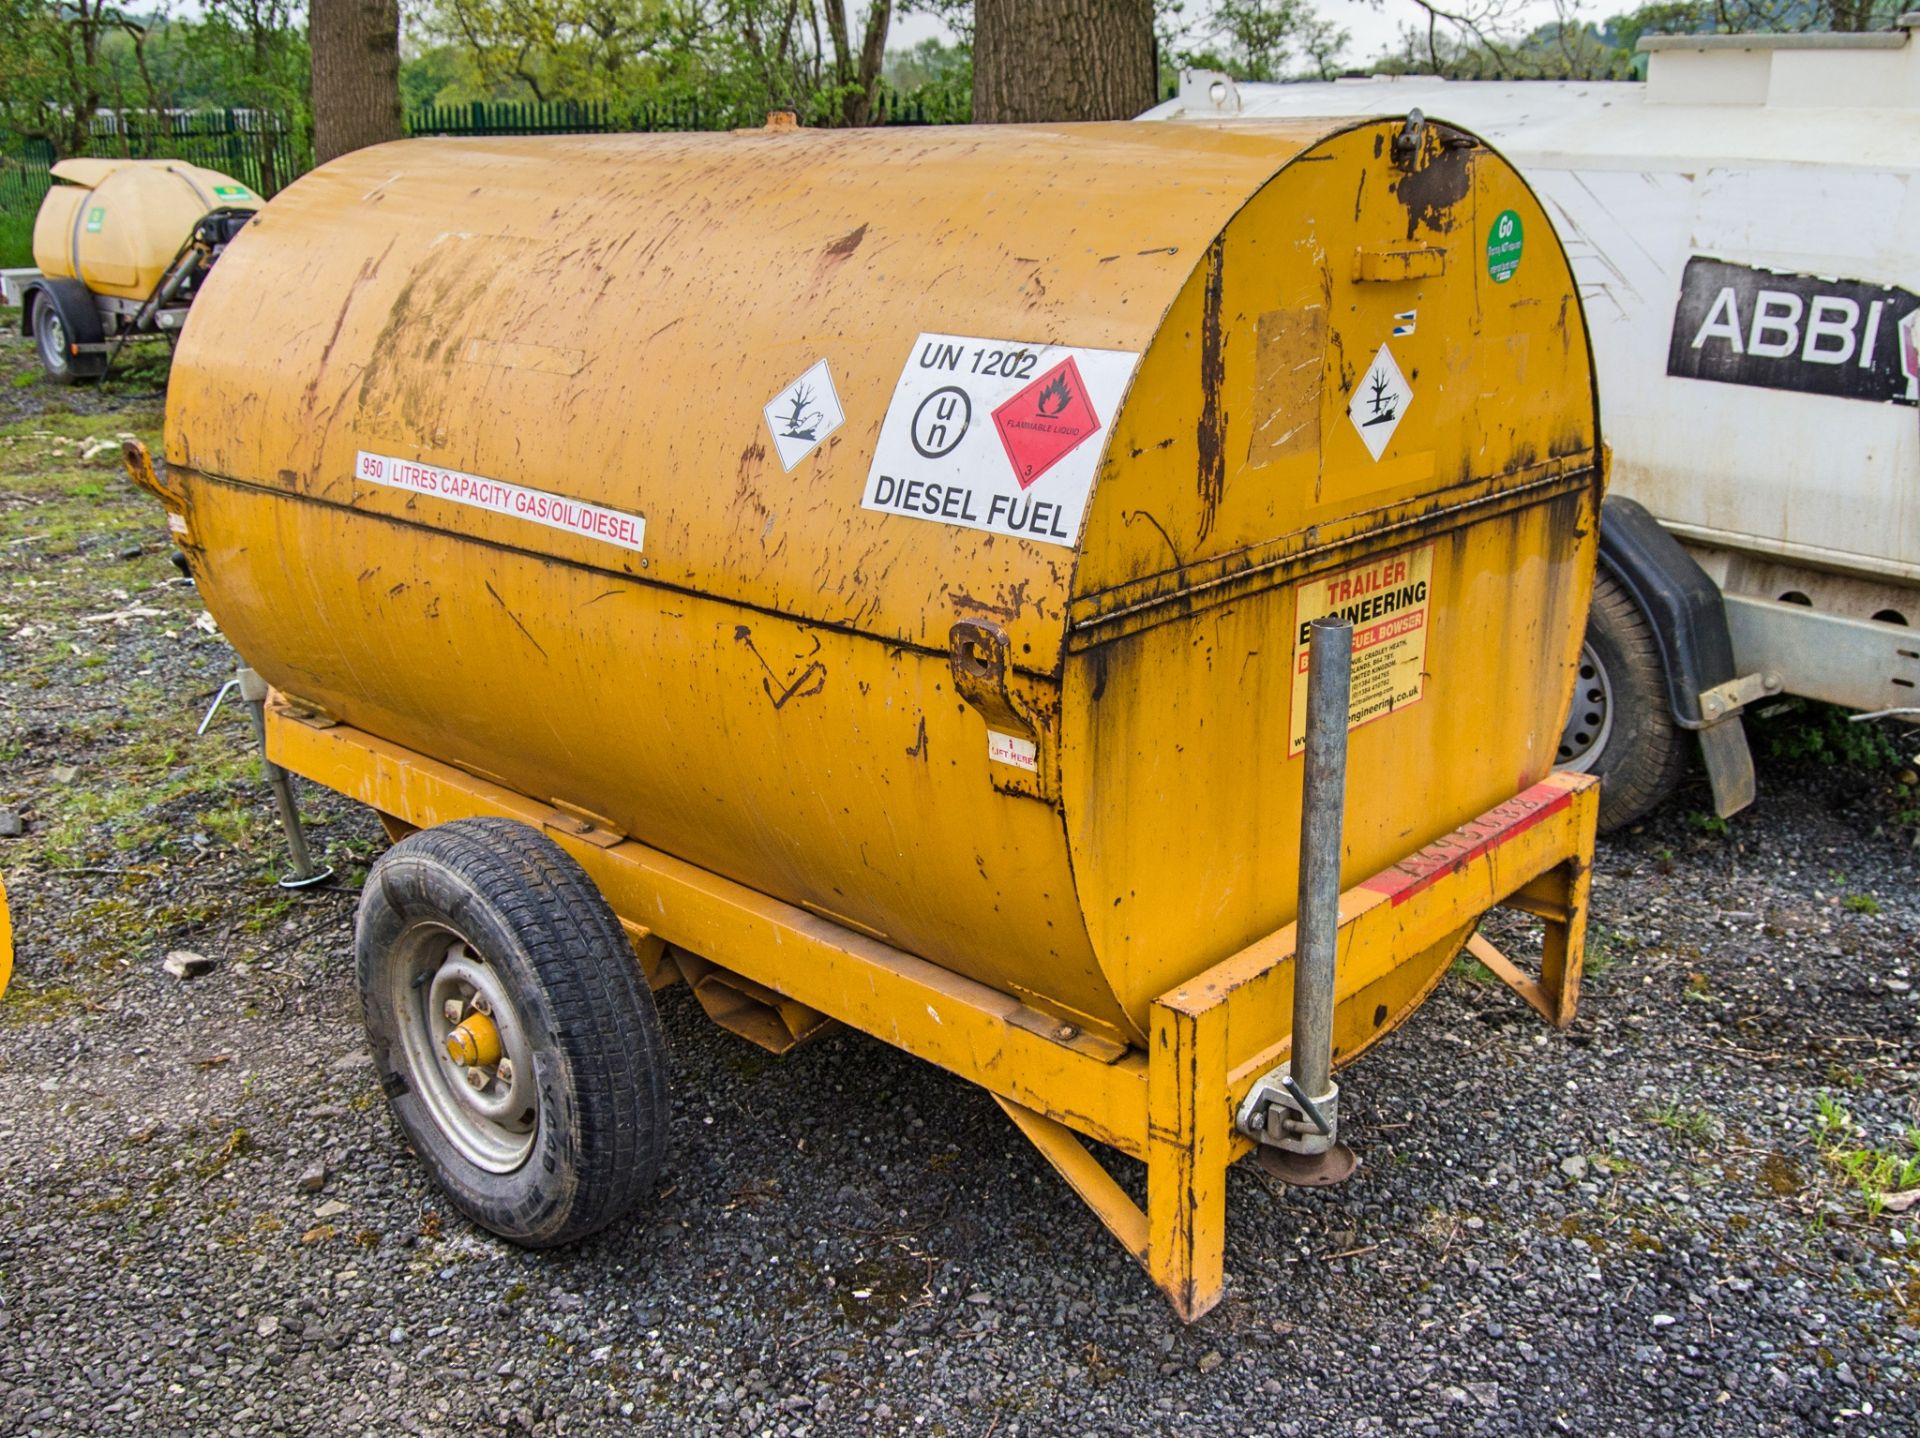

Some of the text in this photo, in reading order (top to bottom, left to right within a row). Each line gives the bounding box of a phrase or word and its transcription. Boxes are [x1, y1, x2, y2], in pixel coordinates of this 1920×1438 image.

[1499, 215, 1513, 238] Go
[1691, 287, 1885, 369] ABBI
[919, 342, 1037, 380] UN 1202
[936, 396, 957, 421] u
[926, 423, 947, 447] n
[1006, 419, 1080, 436] FLAMMABLE LIQUID
[1024, 464, 1033, 476] 3
[363, 457, 640, 545] 950 LITRES CAPACITY GAS/OIL/DIESEL
[873, 475, 1068, 538] DIESEL FUEL
[1327, 560, 1406, 606] TRAILER
[1379, 612, 1422, 639] BOWSER
[1010, 752, 1033, 765] HERE
